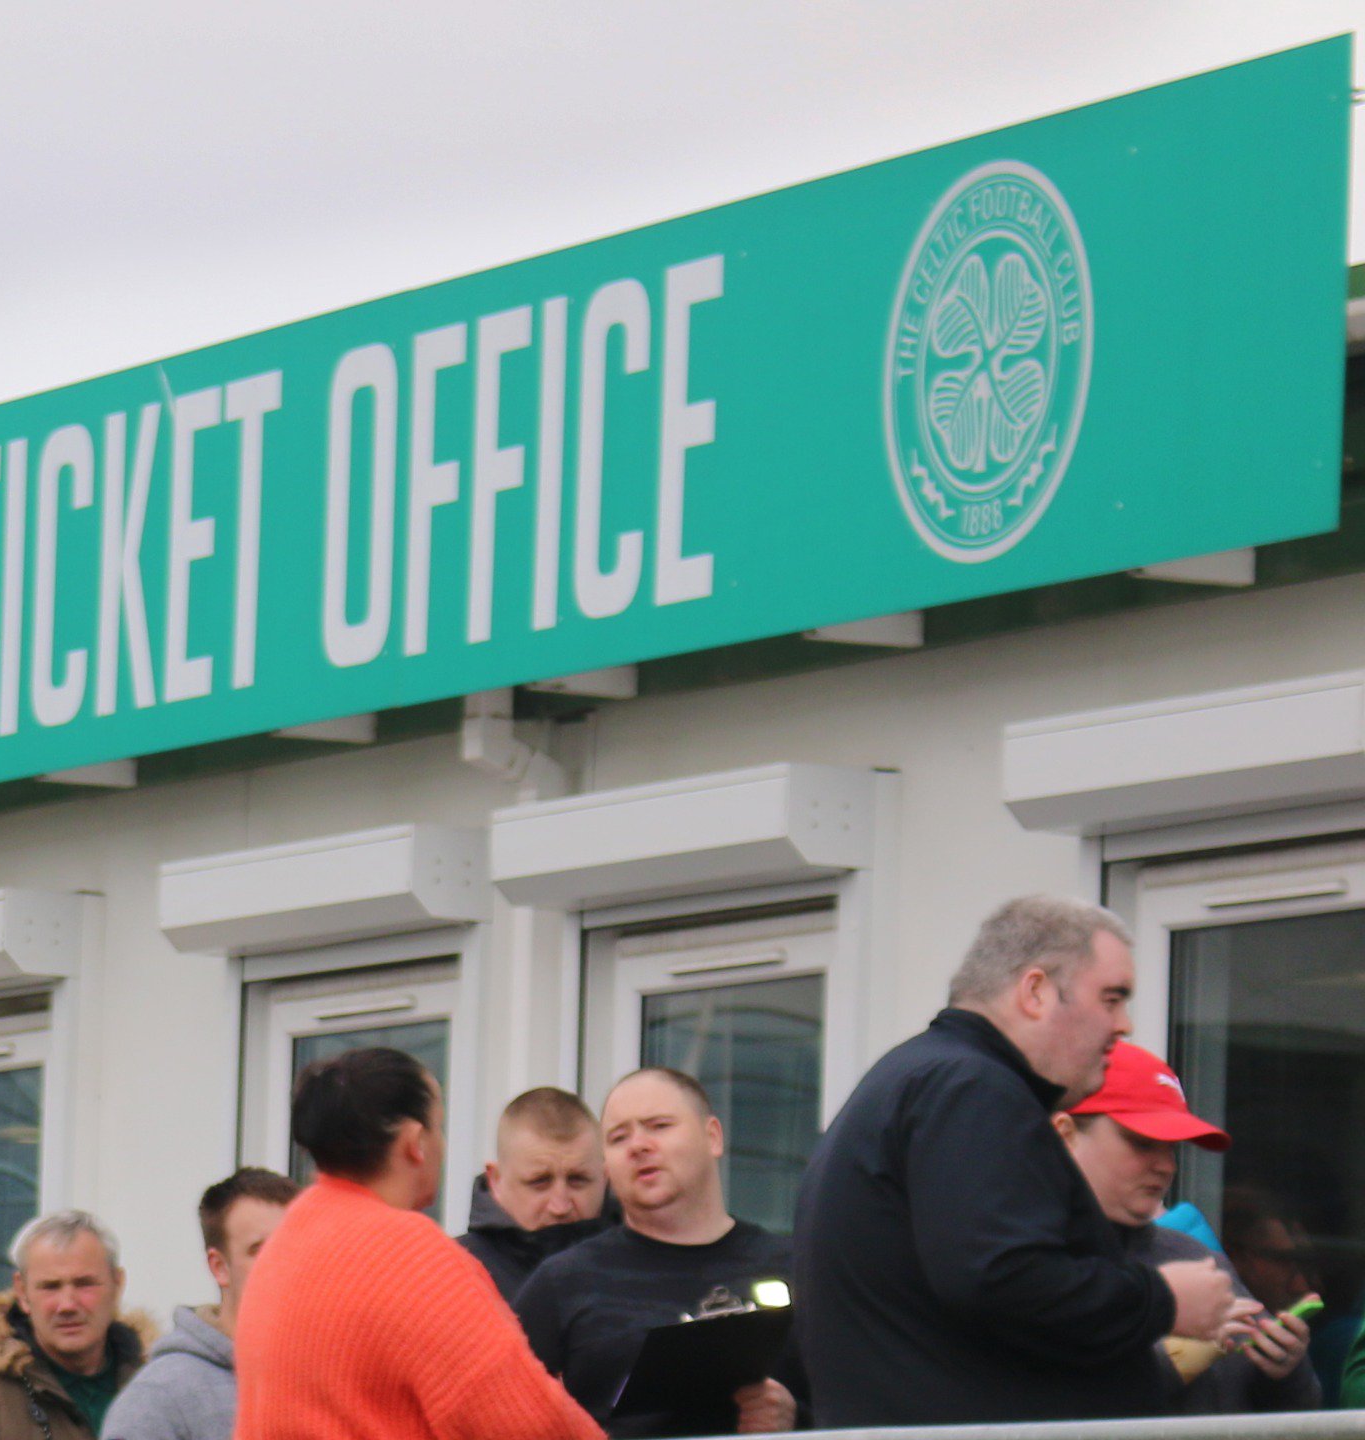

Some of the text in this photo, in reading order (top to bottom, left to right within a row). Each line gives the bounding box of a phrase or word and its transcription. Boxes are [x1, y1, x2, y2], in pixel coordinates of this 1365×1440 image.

[896, 185, 1081, 383] THE CELTIC FOOTBALL CLUB
[321, 253, 725, 669] OFFICE
[961, 498, 1004, 537] 1888
